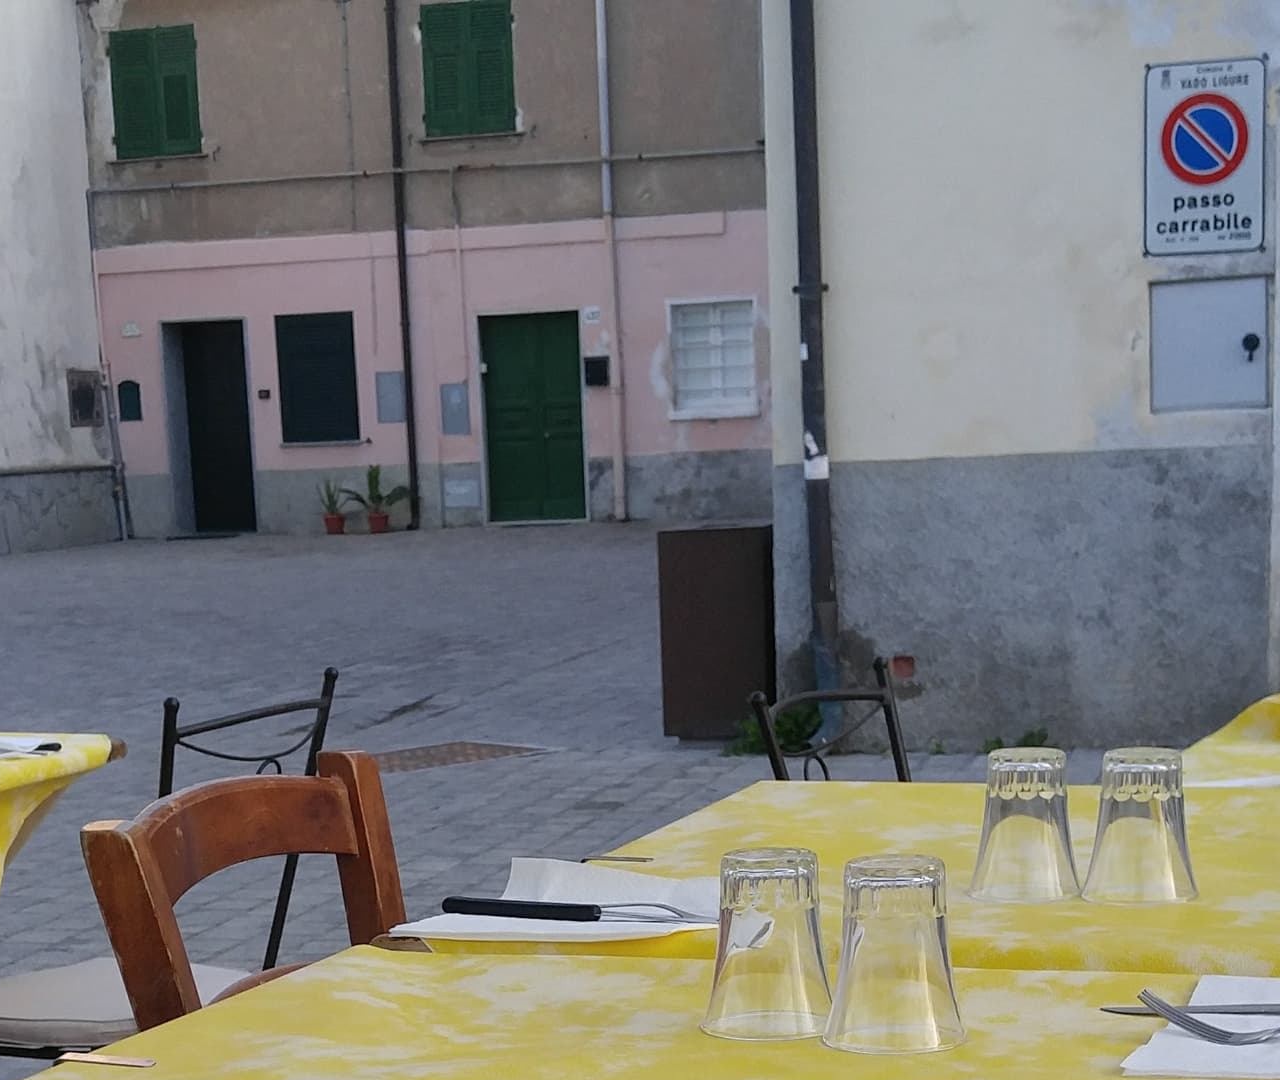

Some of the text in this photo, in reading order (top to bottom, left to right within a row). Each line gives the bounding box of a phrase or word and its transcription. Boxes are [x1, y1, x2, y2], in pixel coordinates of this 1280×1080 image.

[1180, 74, 1249, 89] VADO LIGURE
[1173, 193, 1235, 213] passo
[1156, 212, 1252, 235] carrabile
